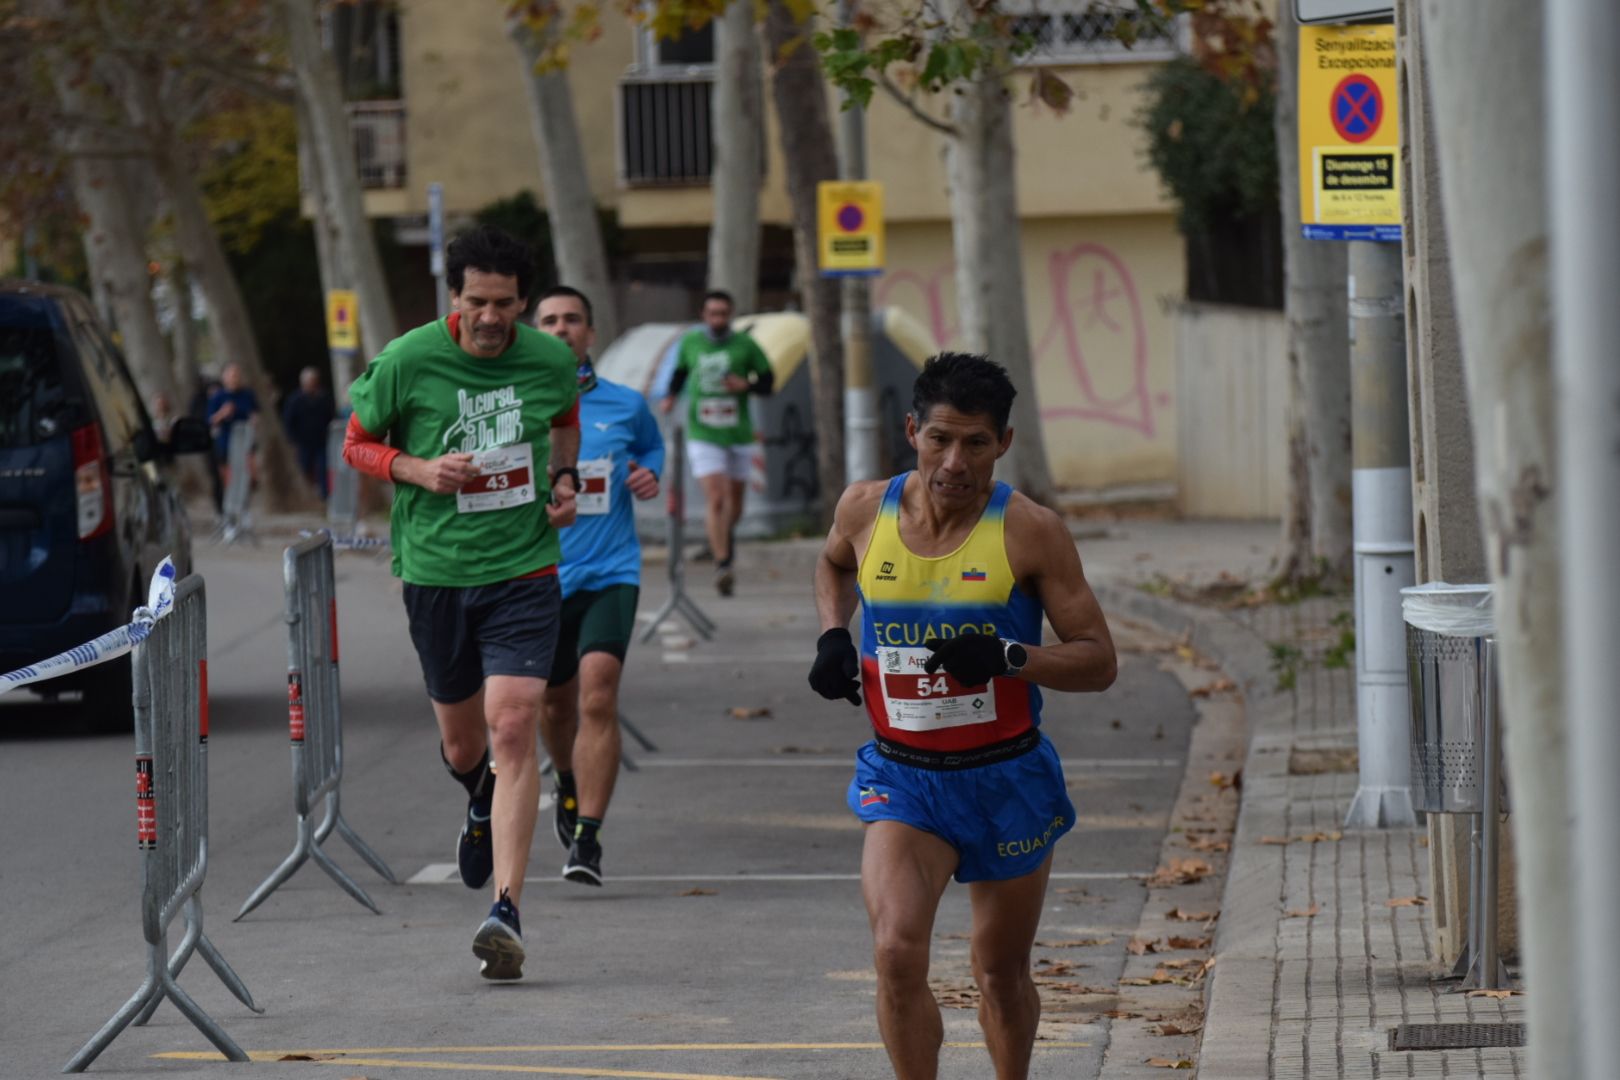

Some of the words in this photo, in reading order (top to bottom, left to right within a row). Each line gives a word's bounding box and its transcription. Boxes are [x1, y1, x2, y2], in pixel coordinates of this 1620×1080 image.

[1325, 159, 1374, 173] Diumenge
[1340, 173, 1388, 185] desembre
[486, 474, 509, 490] 43
[917, 676, 949, 697] 54
[997, 815, 1065, 857] ECUADR
